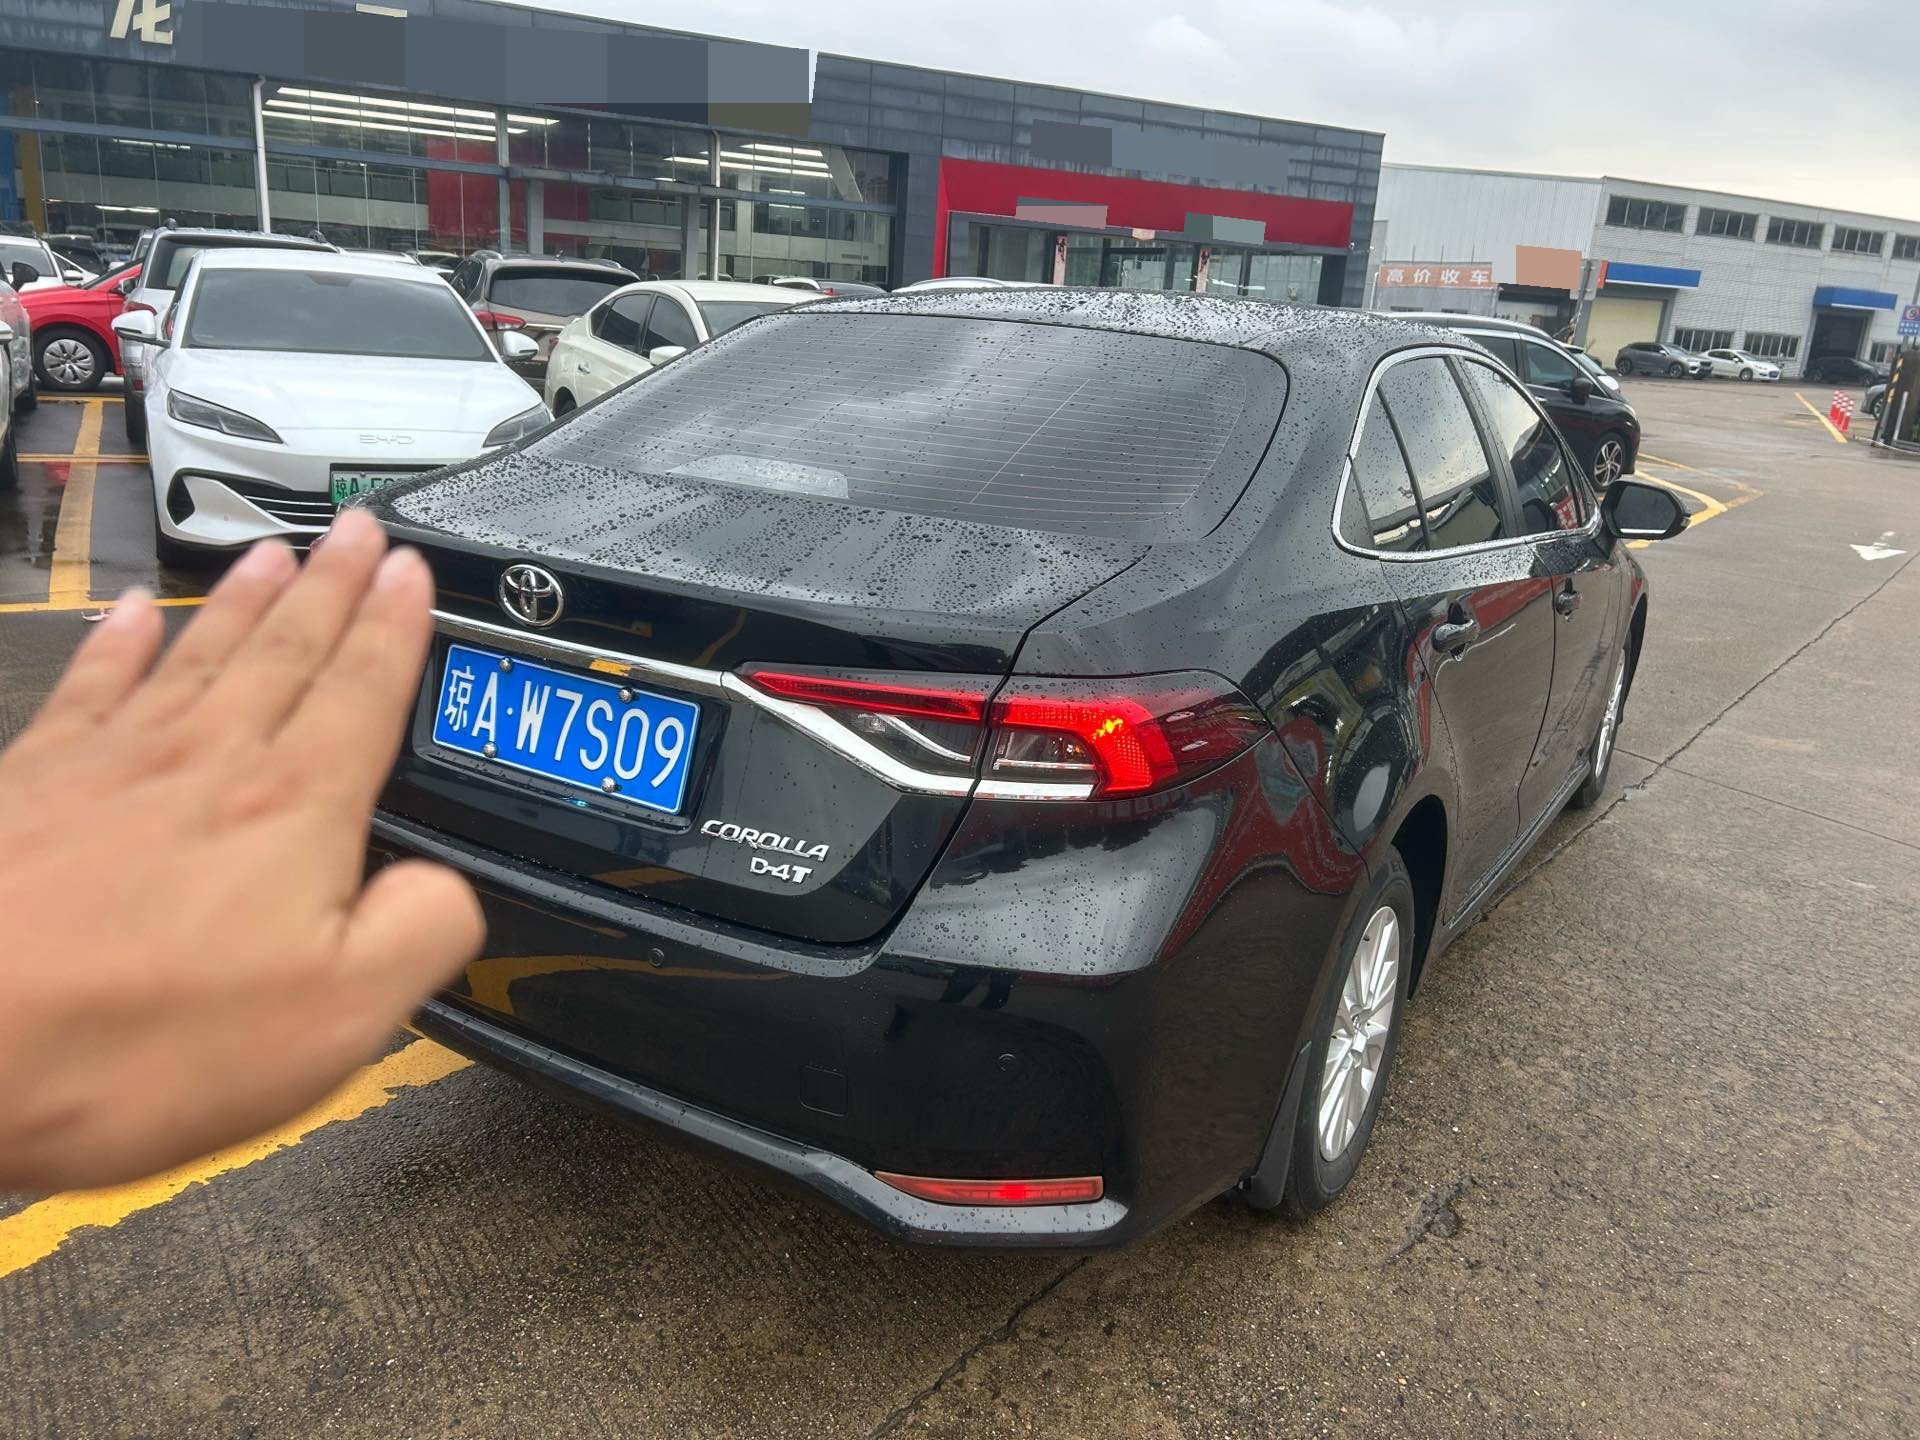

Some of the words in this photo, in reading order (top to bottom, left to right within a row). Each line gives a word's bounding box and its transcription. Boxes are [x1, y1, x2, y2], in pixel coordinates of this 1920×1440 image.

[1386, 268, 1491, 285] 高价收车
[359, 434, 415, 446] BYD
[700, 819, 830, 862] COROLLA
[749, 856, 813, 883] D-4T
